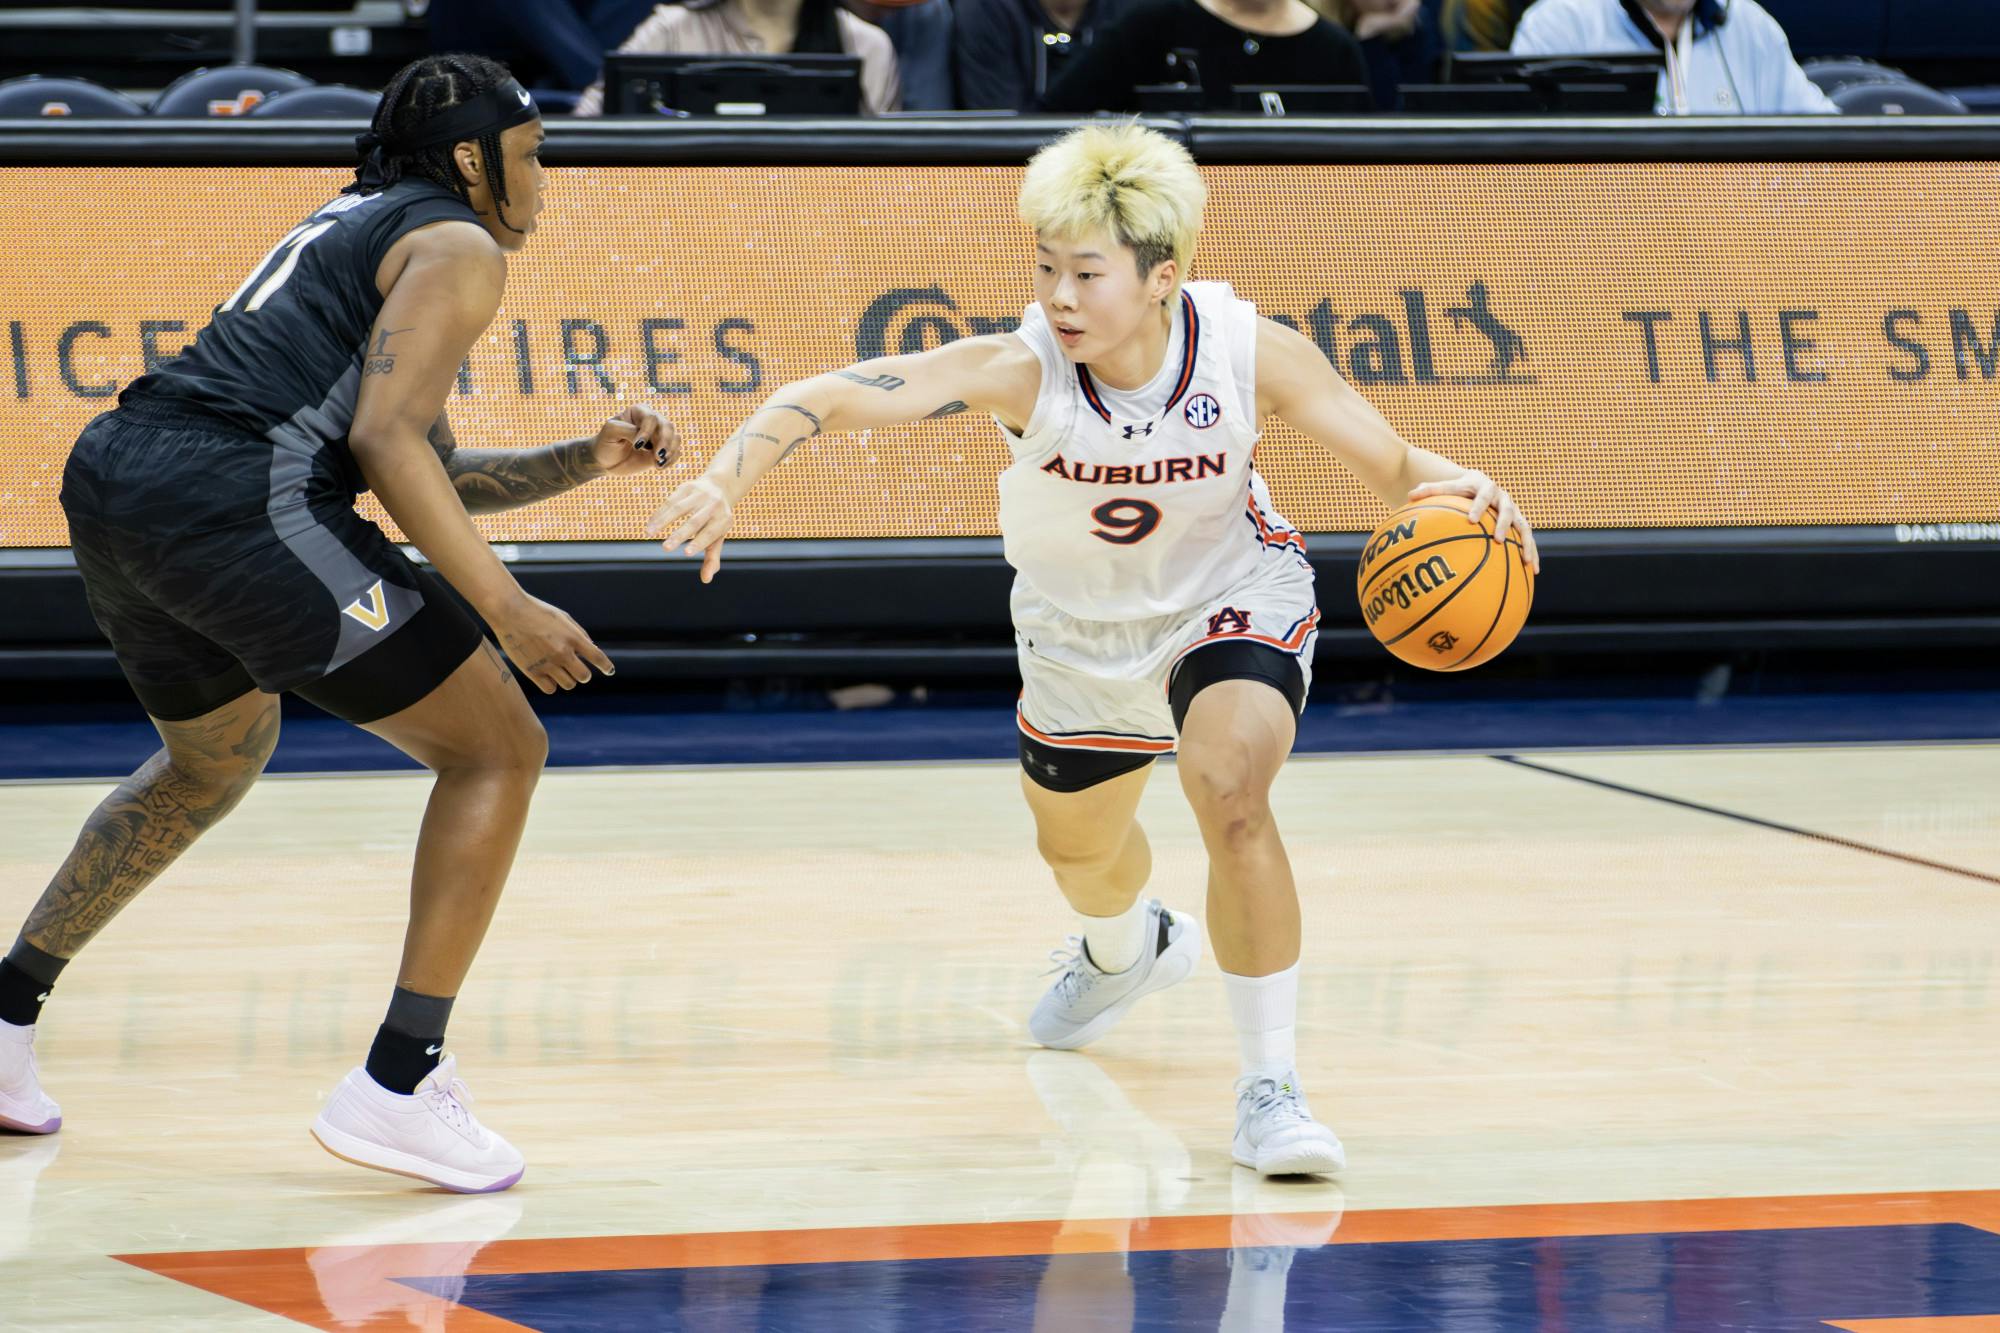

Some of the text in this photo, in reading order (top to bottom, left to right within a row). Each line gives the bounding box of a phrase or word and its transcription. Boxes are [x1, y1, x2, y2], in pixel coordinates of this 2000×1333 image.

[1622, 308, 2000, 383] THE SM
[1185, 394, 1220, 428] SEC
[1040, 452, 1227, 485] AUBURN
[1089, 498, 1163, 545] 9
[341, 579, 390, 631] V
[1365, 555, 1457, 625] Wilson
